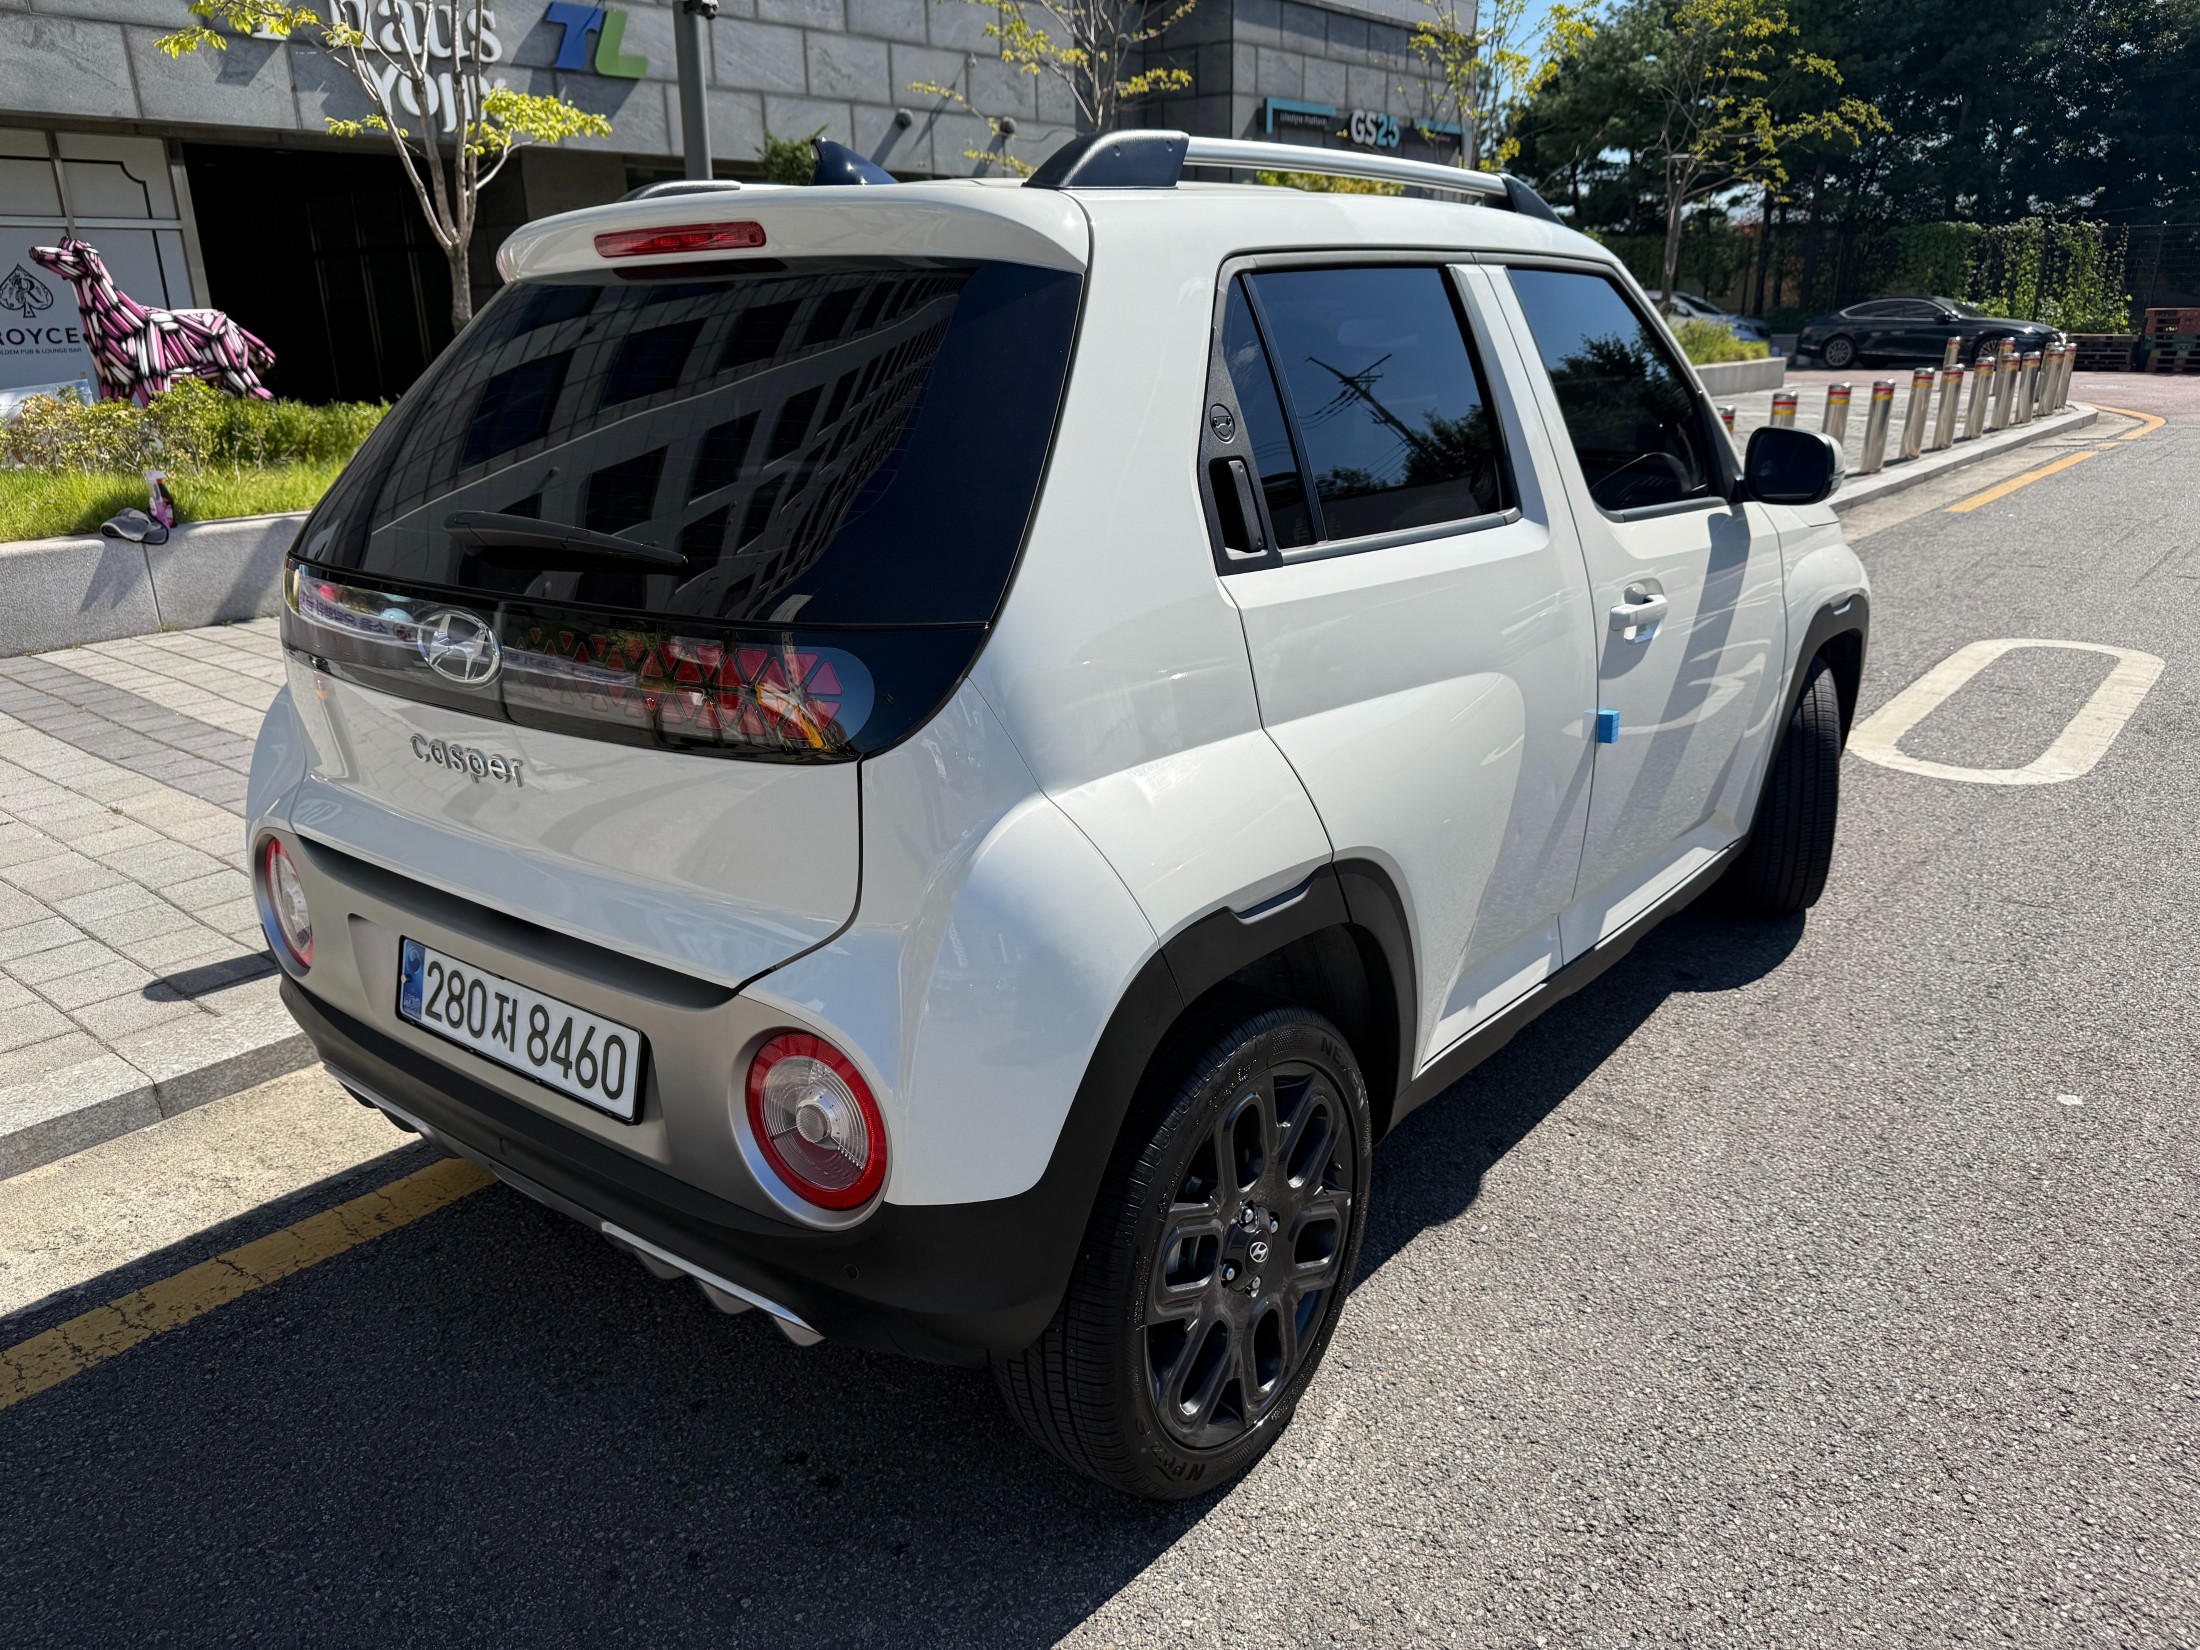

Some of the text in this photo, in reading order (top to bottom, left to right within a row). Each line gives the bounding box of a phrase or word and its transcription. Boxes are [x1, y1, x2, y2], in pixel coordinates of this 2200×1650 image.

[1351, 108, 1400, 148] GS25
[0, 327, 80, 346] OYCE
[410, 733, 523, 787] casper
[425, 960, 627, 1100] 280저 8460
